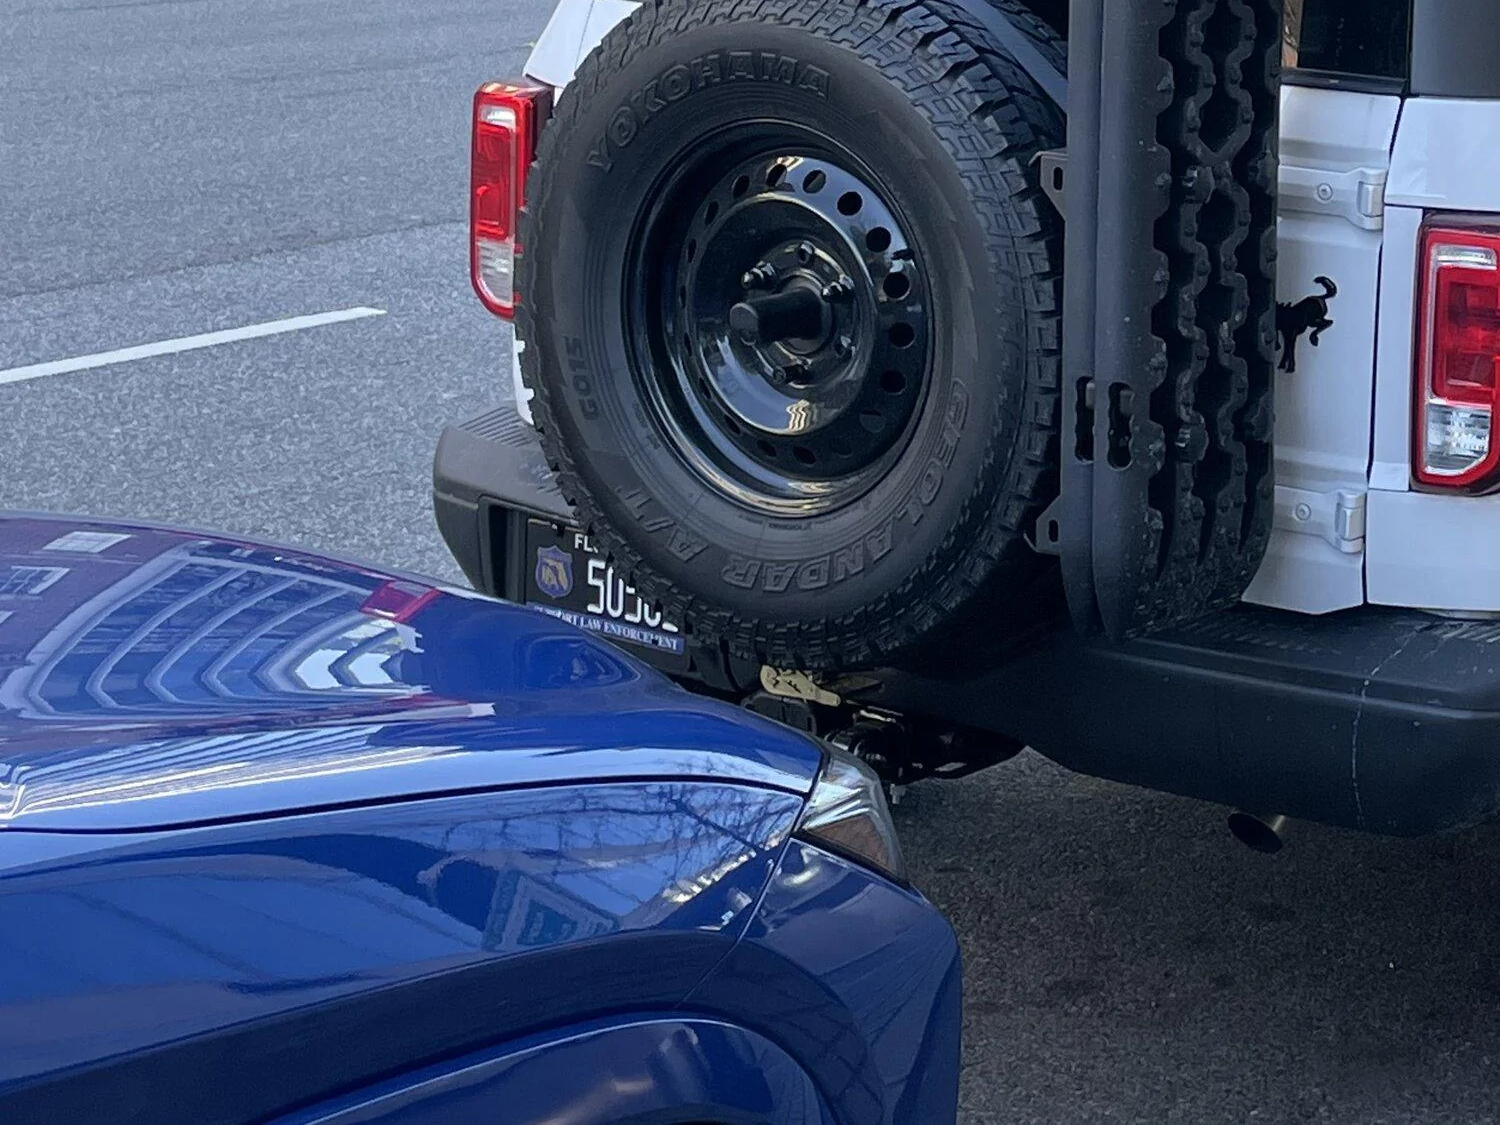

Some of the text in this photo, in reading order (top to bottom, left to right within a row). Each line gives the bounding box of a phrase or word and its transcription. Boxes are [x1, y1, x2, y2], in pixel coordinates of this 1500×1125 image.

[586, 50, 832, 173] YOKOHAMA
[721, 377, 970, 593] GEOLANDAR
[580, 616, 603, 631] LAW
